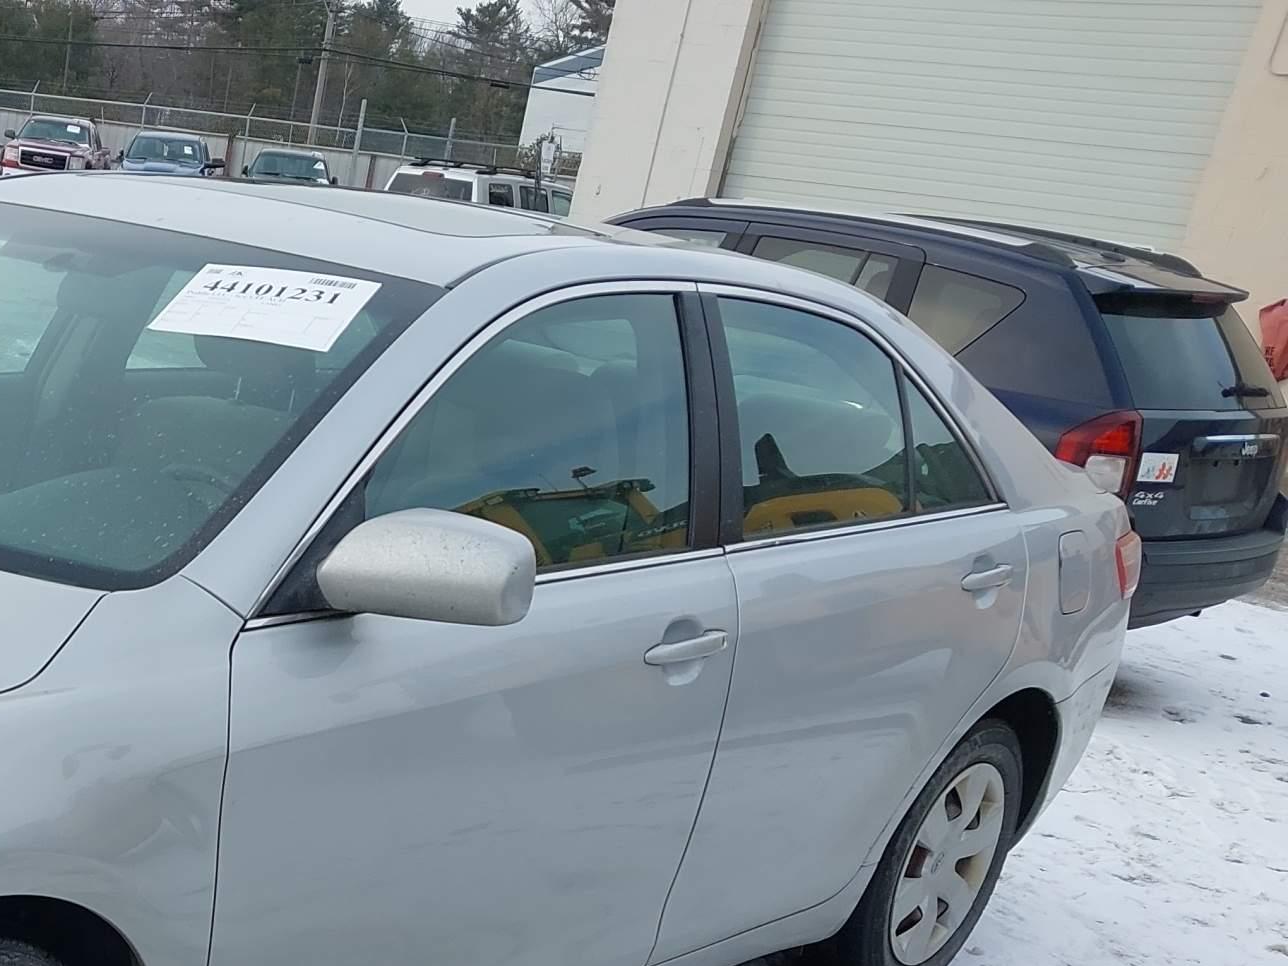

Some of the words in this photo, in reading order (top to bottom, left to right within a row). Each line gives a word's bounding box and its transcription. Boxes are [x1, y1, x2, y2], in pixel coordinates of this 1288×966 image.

[32, 155, 54, 163] GMC
[203, 279, 340, 304] 44101231
[1242, 441, 1258, 457] Jeep
[1134, 491, 1164, 499] 4x4
